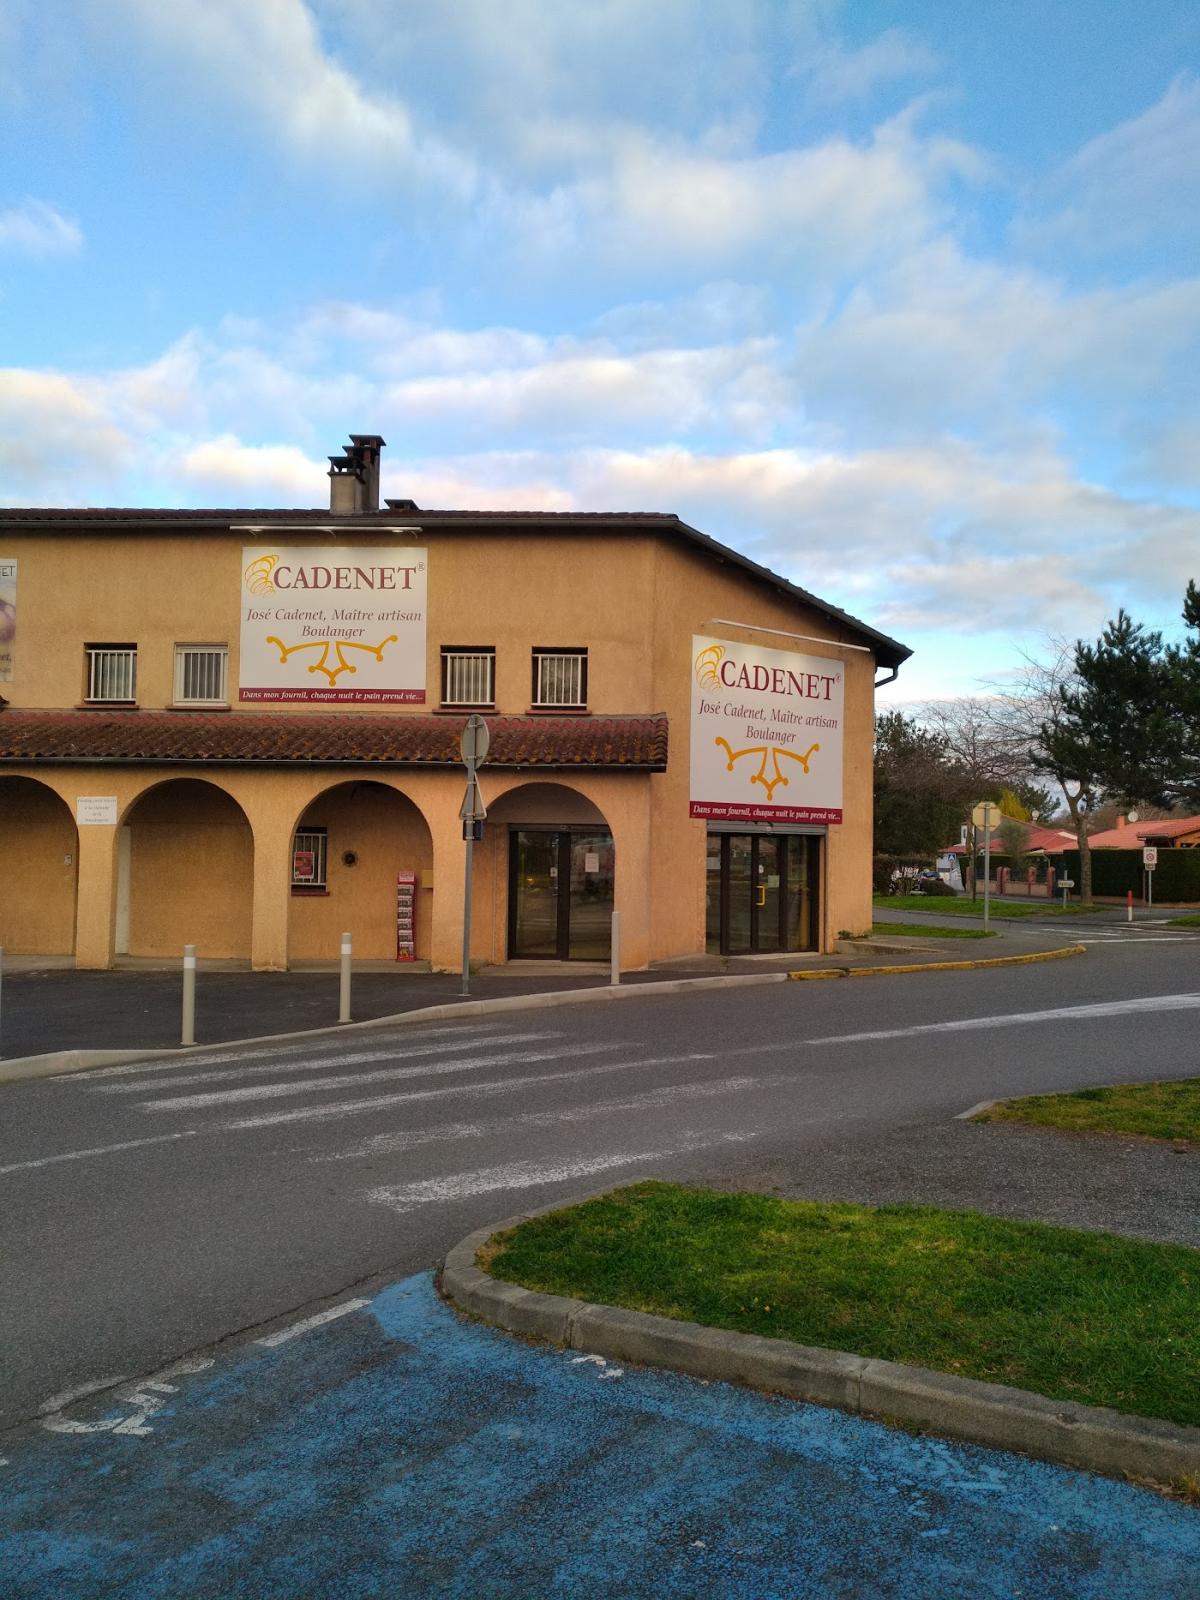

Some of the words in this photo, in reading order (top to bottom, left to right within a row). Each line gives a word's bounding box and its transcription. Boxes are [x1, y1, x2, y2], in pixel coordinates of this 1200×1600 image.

[246, 608, 271, 622] José
[275, 608, 327, 622] Cadenet,
[331, 609, 375, 621] Maître
[377, 609, 422, 621] artisan
[301, 625, 365, 639] Boulanger
[280, 691, 308, 700] fournil,
[310, 691, 337, 700] chaque
[363, 692, 381, 700] pain
[382, 692, 404, 701] prend
[698, 699, 721, 716] José
[724, 703, 767, 721] Cadenet,
[770, 708, 803, 725] Maître
[805, 713, 838, 729] artisan
[745, 725, 797, 745] Boulanger
[693, 805, 711, 814] Dans
[712, 806, 727, 815] mon
[726, 806, 752, 817] fournil,
[752, 807, 775, 818] chaque
[775, 808, 788, 817] nuit
[789, 809, 796, 818] le
[796, 810, 810, 819] pain
[810, 810, 827, 820] prend
